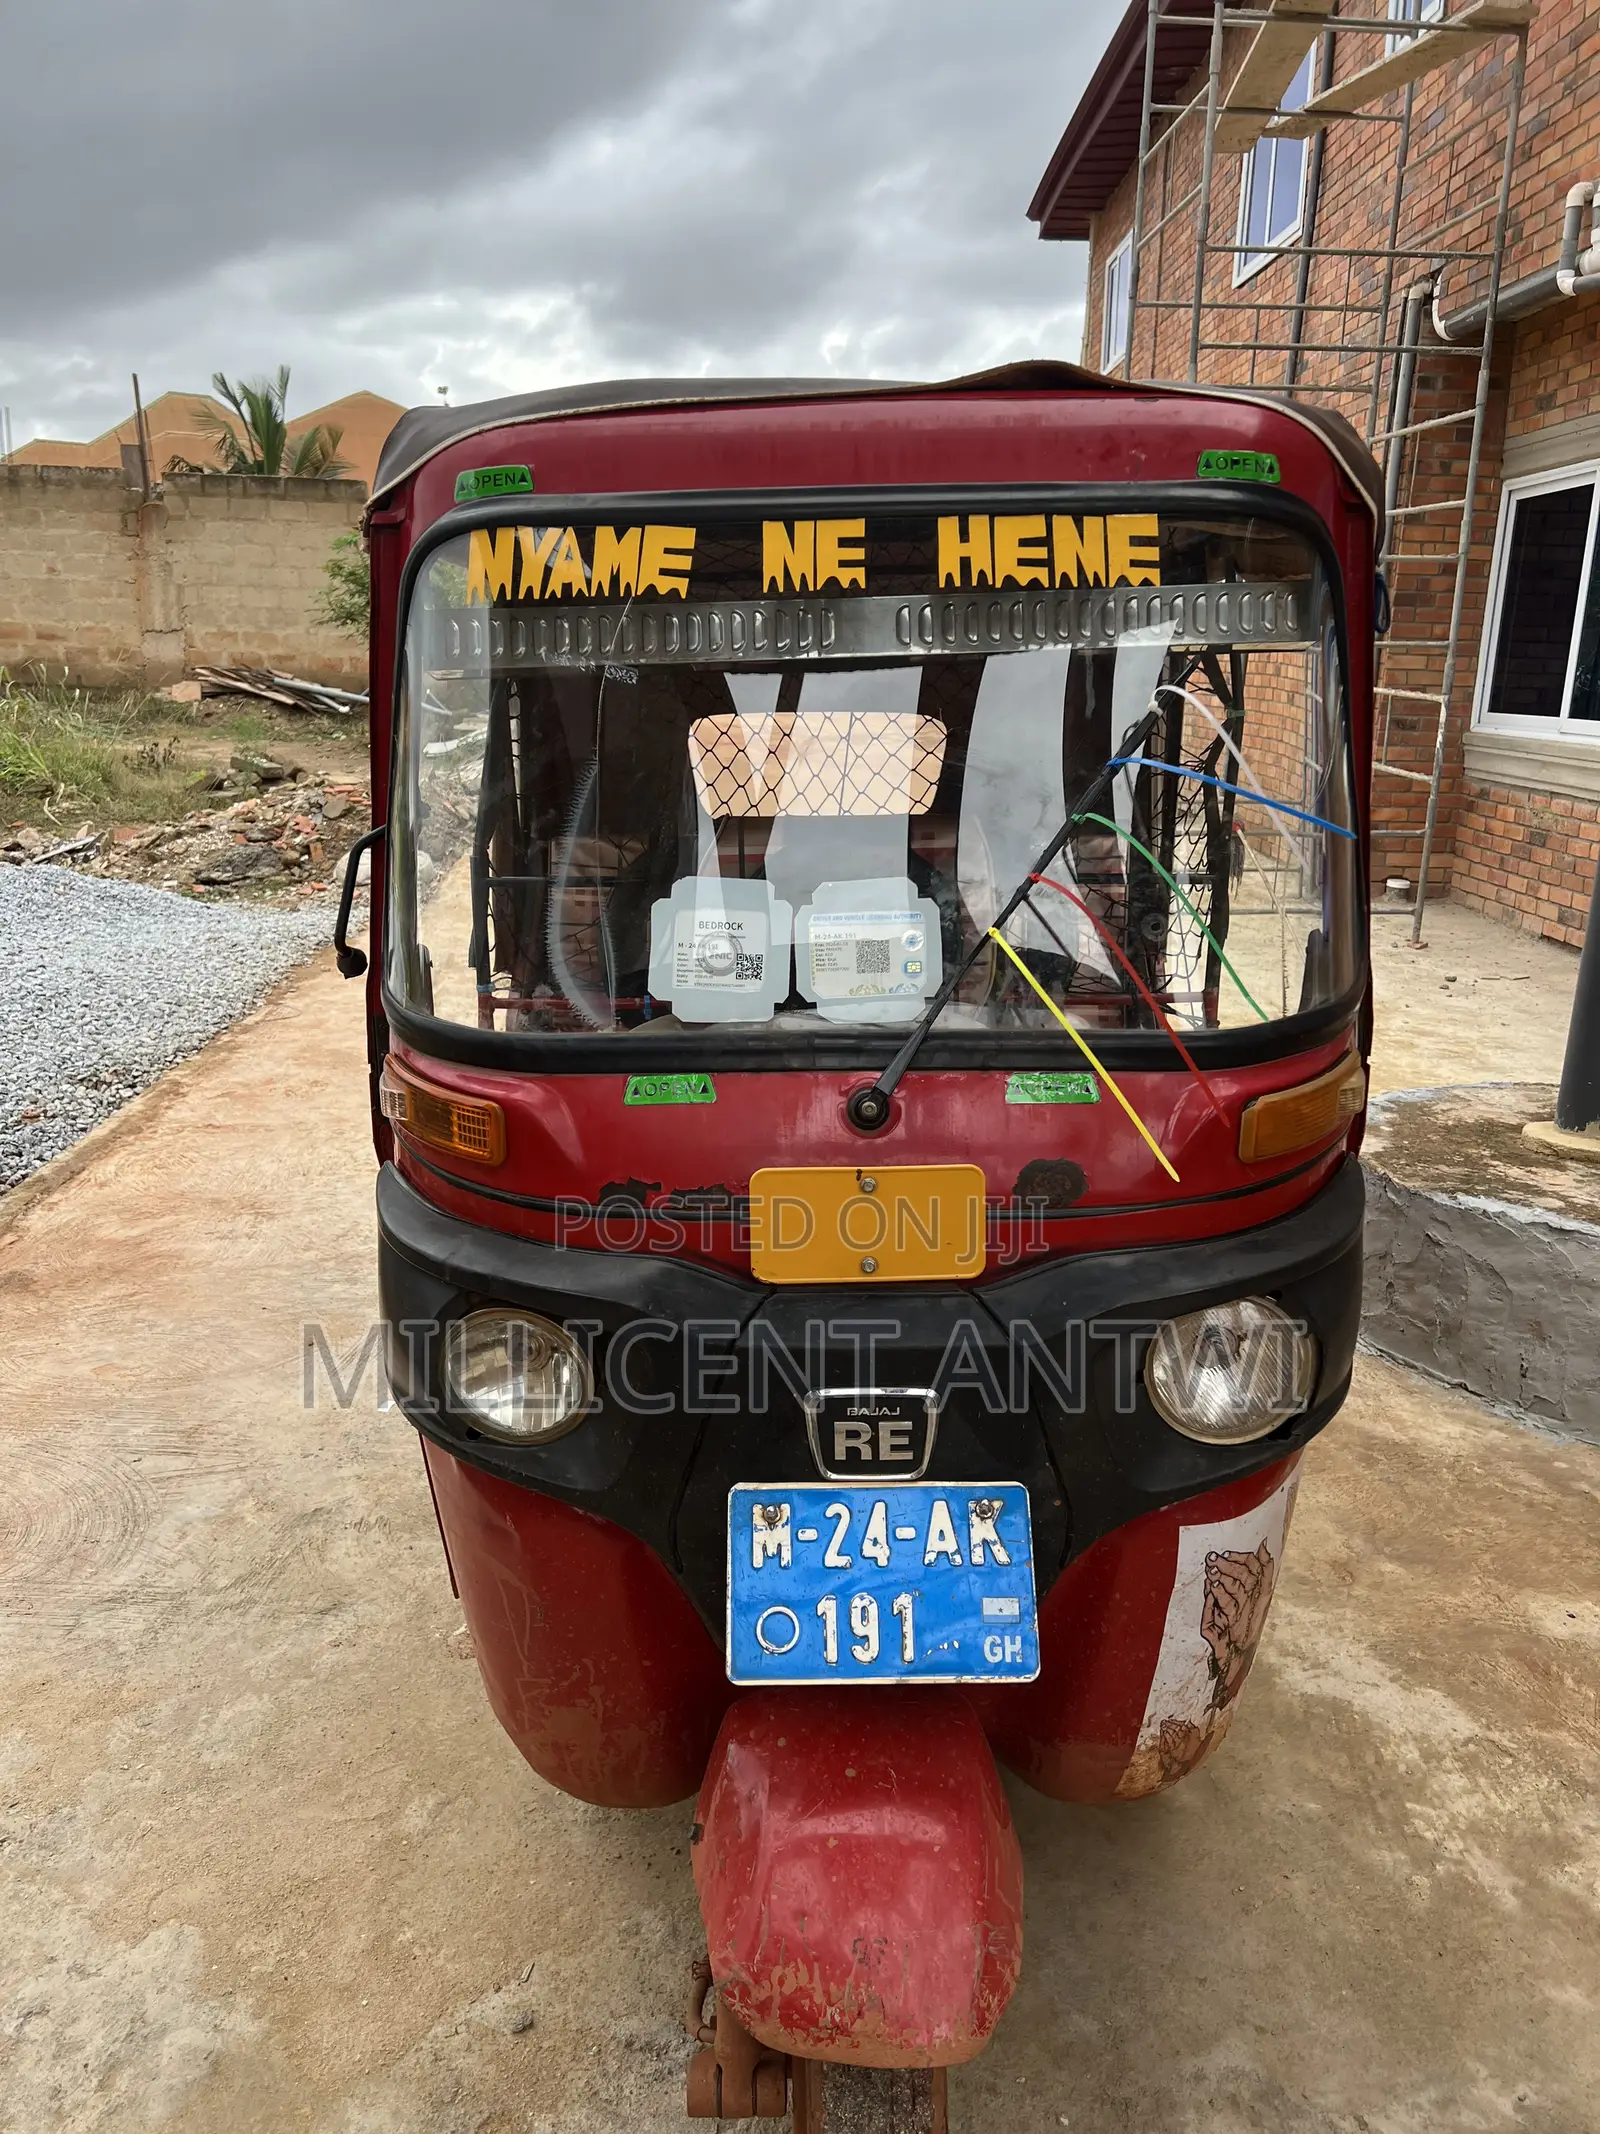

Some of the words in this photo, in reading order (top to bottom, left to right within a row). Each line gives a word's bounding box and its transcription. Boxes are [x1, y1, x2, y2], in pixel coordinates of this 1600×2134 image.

[1216, 457, 1265, 473] OPEN
[469, 472, 516, 490] OPEN
[467, 524, 697, 604] NYAME
[762, 518, 866, 593] NE
[938, 514, 1160, 588] HENE
[698, 921, 744, 931] BEDROCK
[644, 1082, 697, 1097] OPEN
[846, 1406, 901, 1417] BAJAJ
[833, 1421, 915, 1462] RE
[751, 1499, 1012, 1569] M-24-AK
[815, 1591, 917, 1665] 191
[983, 1634, 1023, 1664] GH
